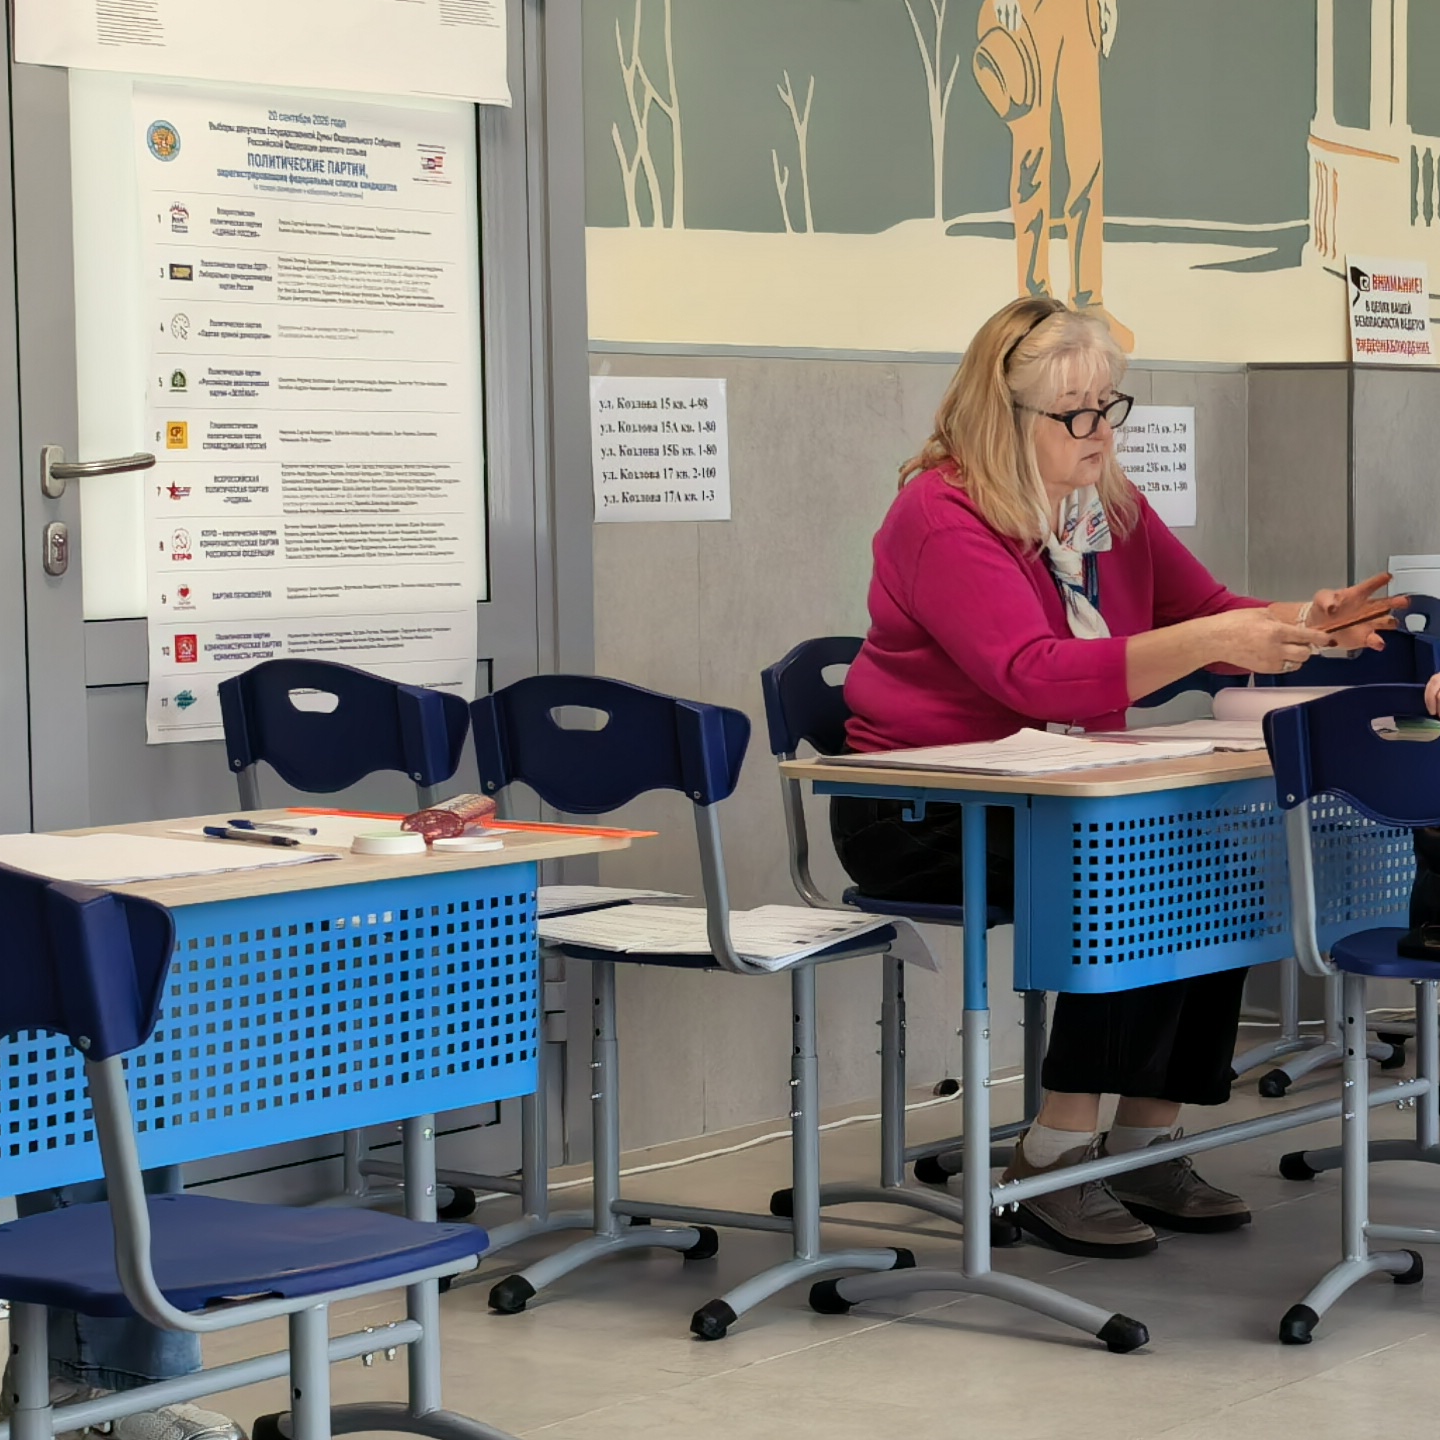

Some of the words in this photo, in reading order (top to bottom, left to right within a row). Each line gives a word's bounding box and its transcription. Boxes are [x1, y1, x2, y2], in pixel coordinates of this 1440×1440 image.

[247, 152, 325, 173] ПОЛИТИЧЕСКИЕ
[328, 160, 368, 179] ПАРТИИ,
[1372, 273, 1423, 294] ВНИМАНИЕ!
